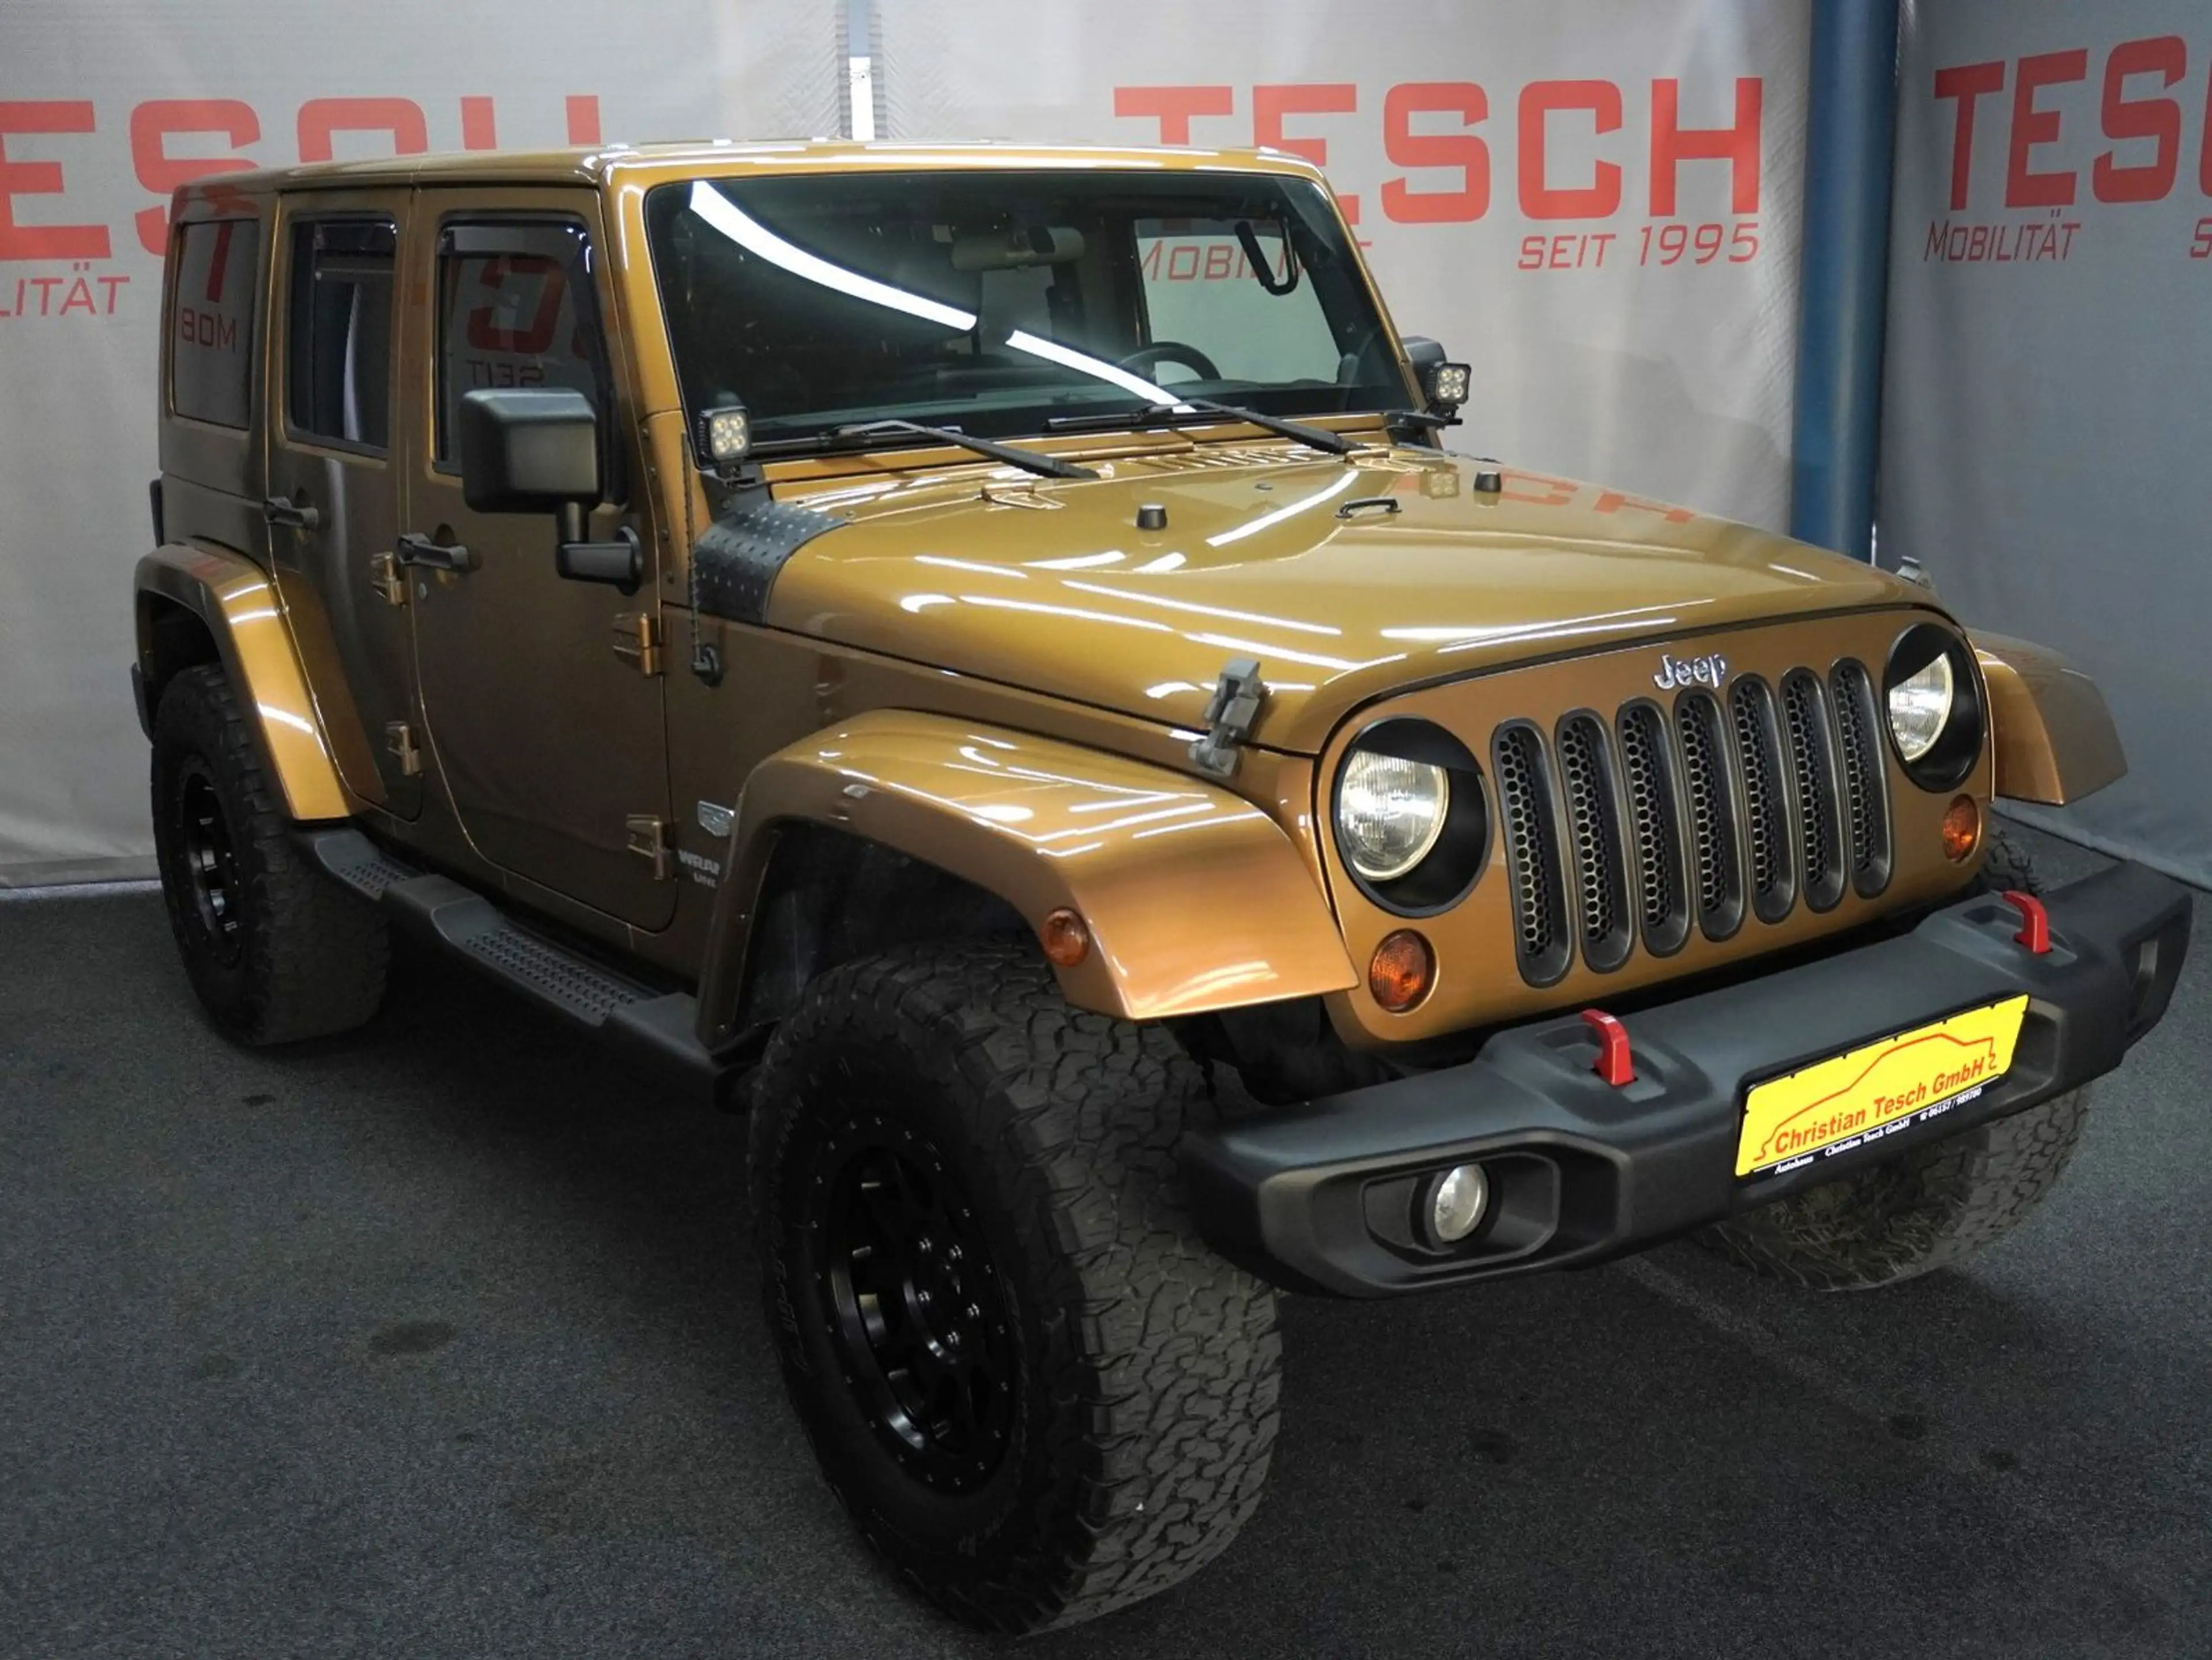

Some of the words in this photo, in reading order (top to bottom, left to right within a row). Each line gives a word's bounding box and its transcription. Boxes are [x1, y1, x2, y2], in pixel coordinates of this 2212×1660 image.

[1933, 35, 2212, 211] TES
[1517, 233, 1617, 270] SEIT
[1638, 222, 1760, 267] 1995
[1923, 208, 2081, 262] MOBILITÄT
[0, 261, 130, 317] ITÄT
[1653, 653, 1726, 689] Jeep
[1775, 1108, 1866, 1154] Christian
[1873, 1080, 1927, 1119] Tesch
[1932, 1056, 1984, 1095] GmbH
[1824, 1138, 1861, 1157] Christian
